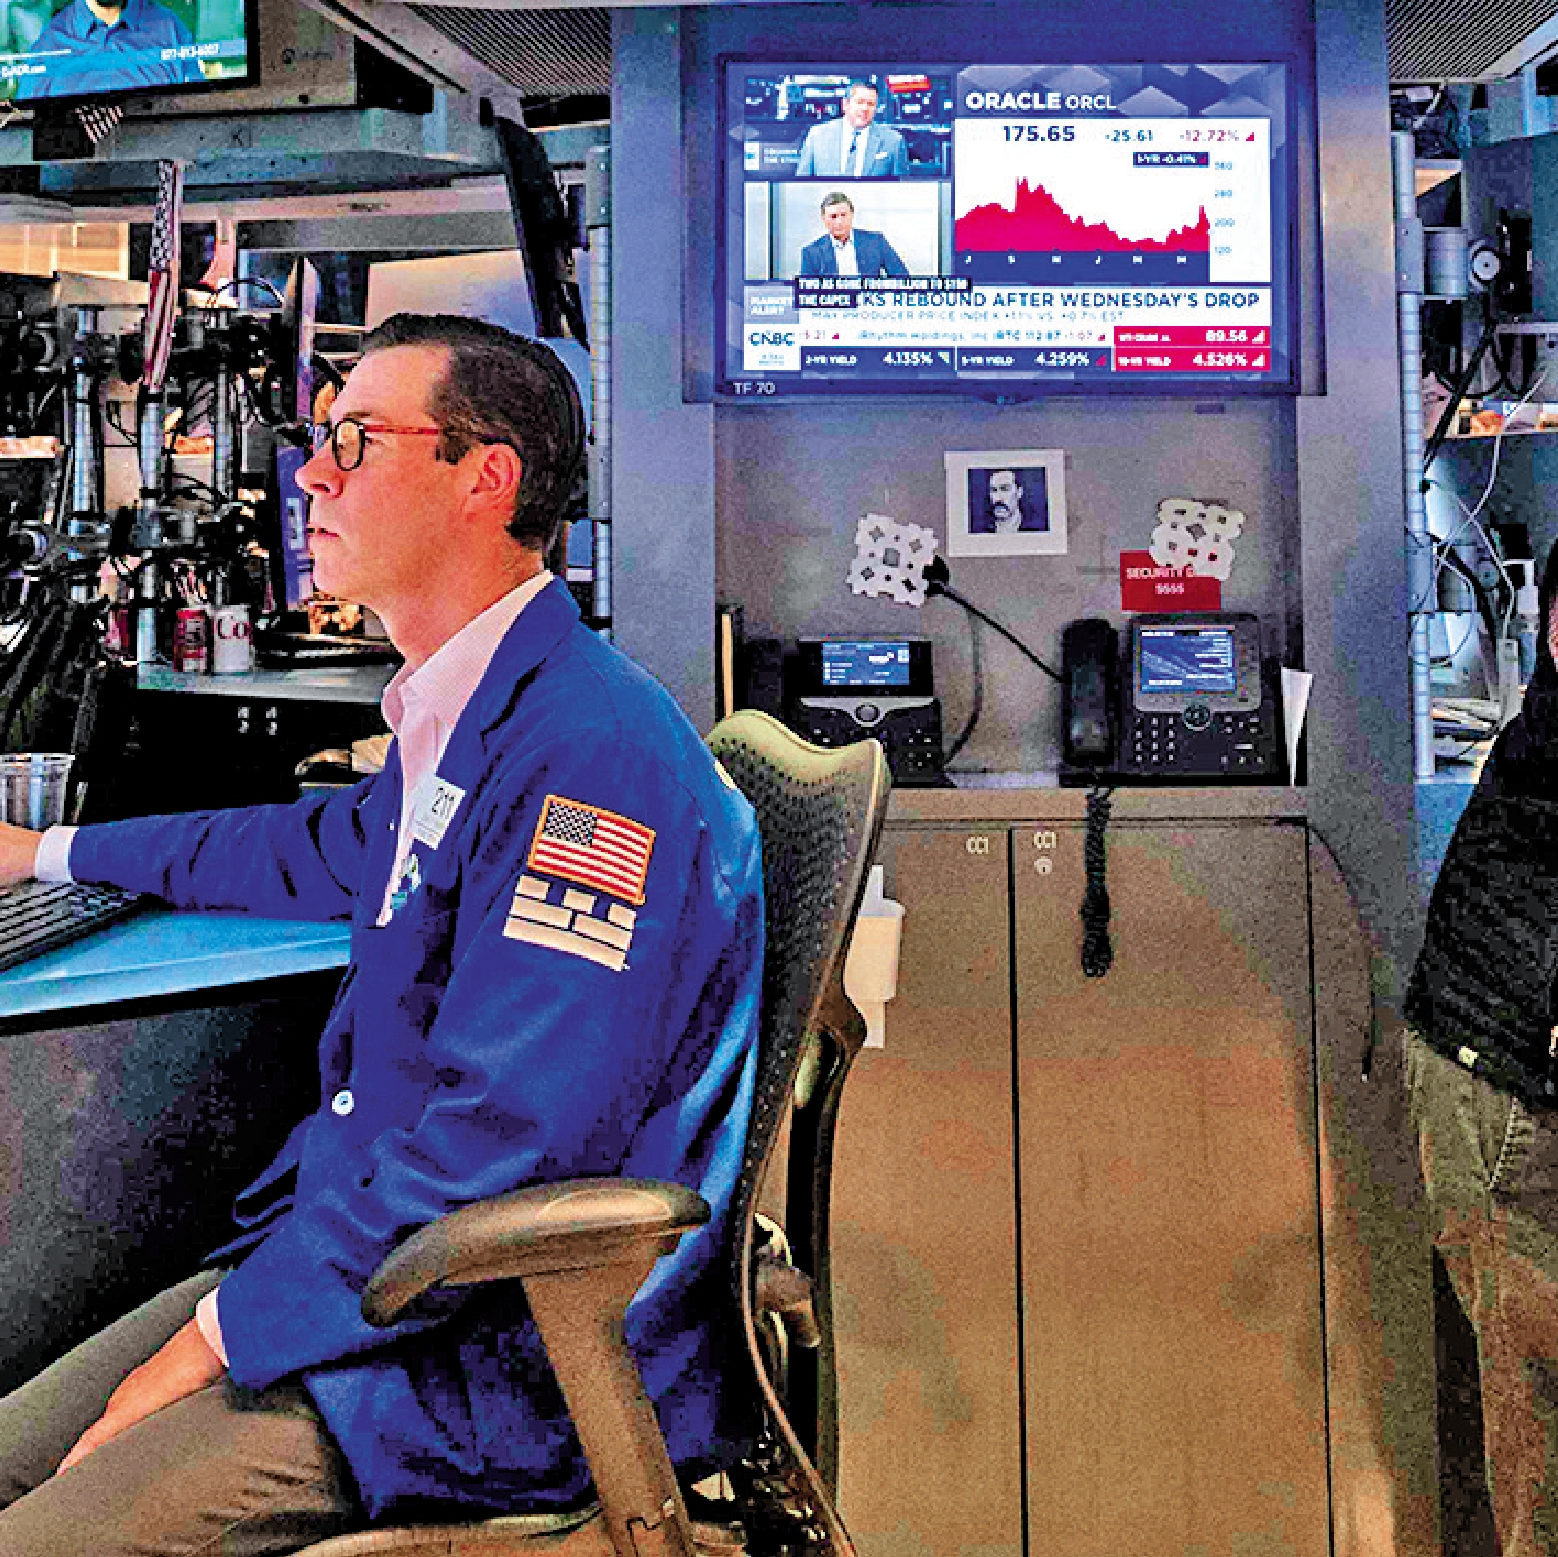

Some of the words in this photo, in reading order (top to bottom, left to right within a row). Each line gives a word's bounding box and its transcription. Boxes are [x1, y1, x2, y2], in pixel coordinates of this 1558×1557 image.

[965, 91, 1062, 111] ORACLE
[1065, 93, 1116, 111] ORCL
[1002, 125, 1075, 142] 175.65
[893, 292, 986, 307] REBOUND
[992, 292, 1054, 307] AFTER
[1060, 292, 1198, 307] WEDNESDAY'S
[1205, 292, 1260, 307] DROP
[732, 382, 751, 395] TF
[756, 382, 776, 395] 70
